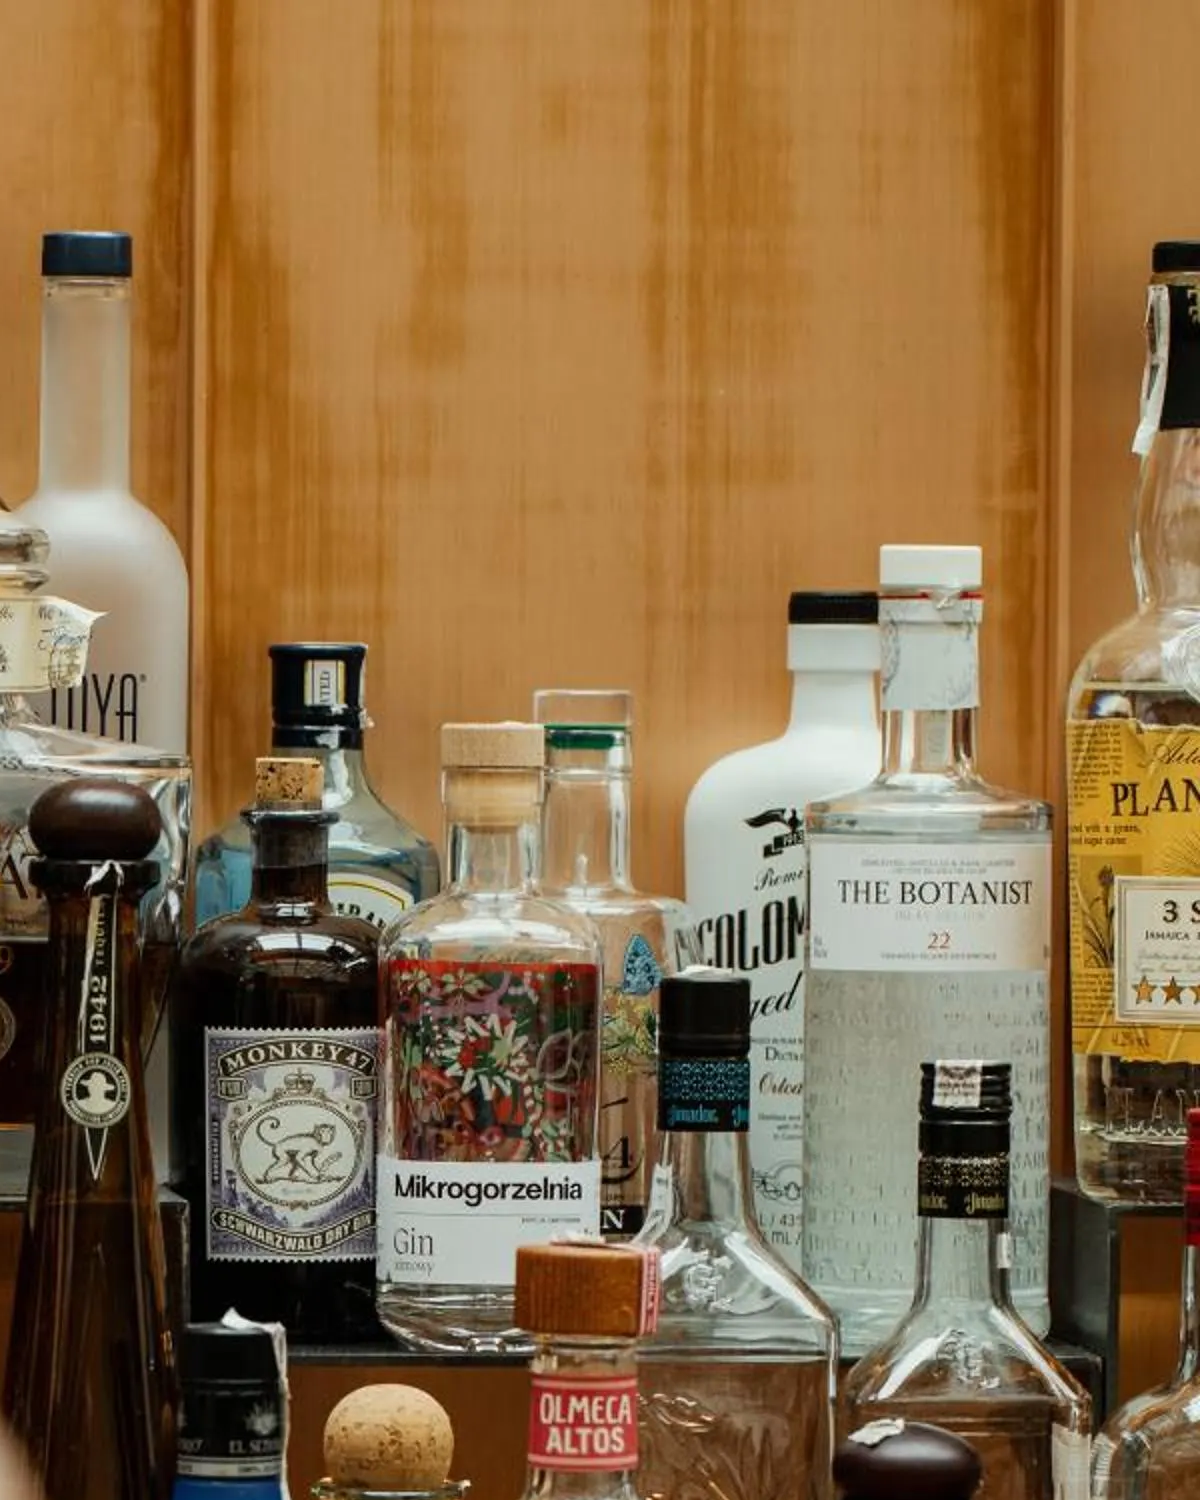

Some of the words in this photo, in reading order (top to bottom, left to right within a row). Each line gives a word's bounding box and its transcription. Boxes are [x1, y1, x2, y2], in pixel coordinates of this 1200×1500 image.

[837, 879, 890, 905] THE
[899, 879, 1033, 905] BOTANIST
[1162, 899, 1179, 924] 3
[927, 932, 950, 949] 22
[89, 975, 108, 1044] 1942
[225, 1042, 343, 1073] MONKEY
[345, 1053, 371, 1070] 47
[394, 1173, 583, 1207] Mikrogorzelnia
[218, 1213, 323, 1251] SCHWARZWALD
[325, 1222, 350, 1243] DRY
[393, 1226, 434, 1258] Gin
[539, 1393, 632, 1425] OLMECA
[545, 1427, 625, 1455] ALTOS
